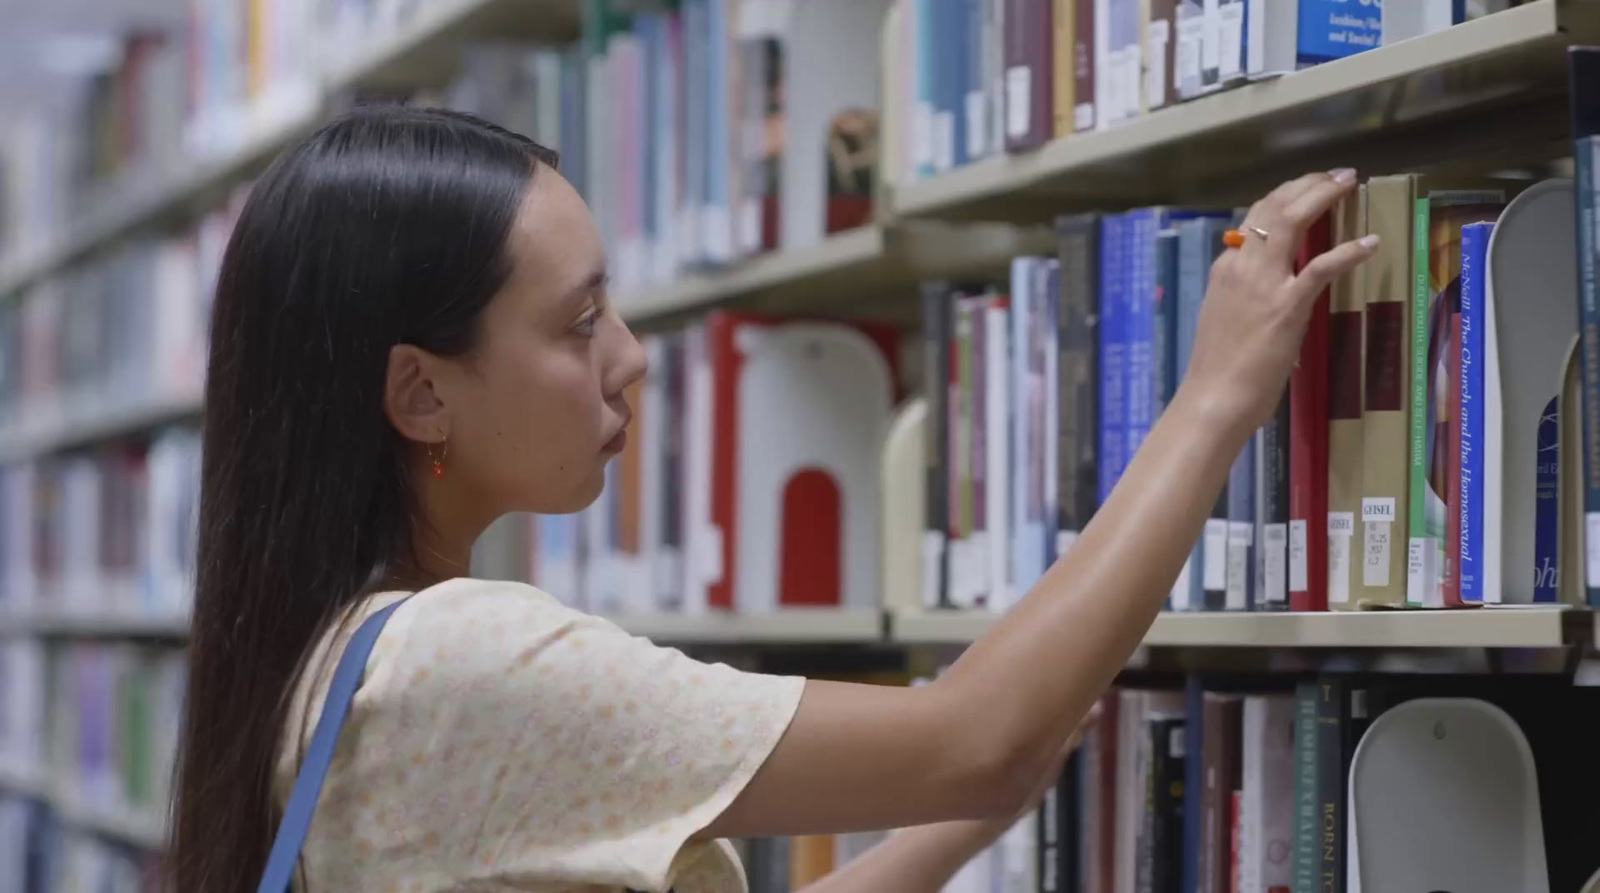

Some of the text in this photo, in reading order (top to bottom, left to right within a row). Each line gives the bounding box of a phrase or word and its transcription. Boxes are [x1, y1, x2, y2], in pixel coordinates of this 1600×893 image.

[1461, 253, 1473, 561] McNeill The Church and the Homosexual
[1364, 504, 1392, 515] GEISEL
[1323, 802, 1336, 861] BORN
